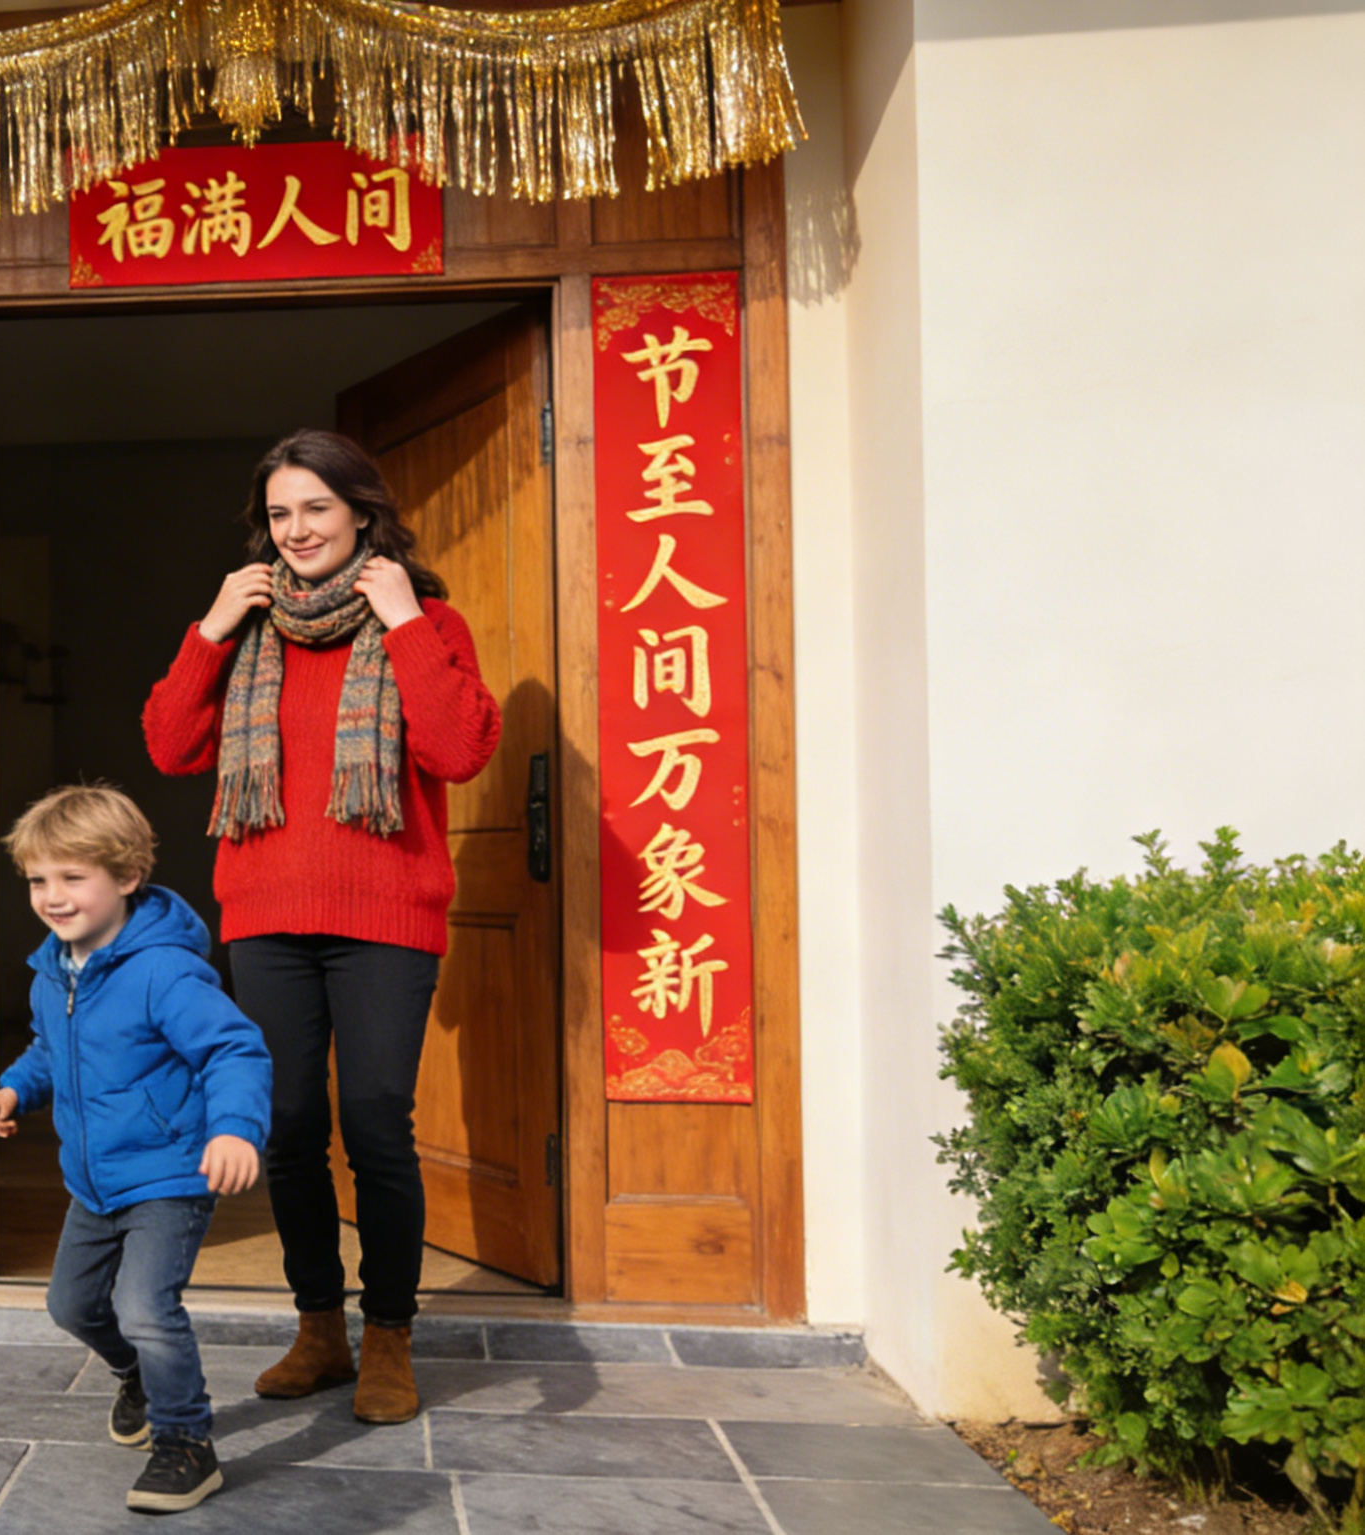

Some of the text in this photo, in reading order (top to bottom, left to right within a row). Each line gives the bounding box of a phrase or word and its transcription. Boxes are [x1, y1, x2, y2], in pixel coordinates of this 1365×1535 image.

[96, 167, 412, 263] 福满人间
[620, 325, 730, 1038] 节至人间万象新
